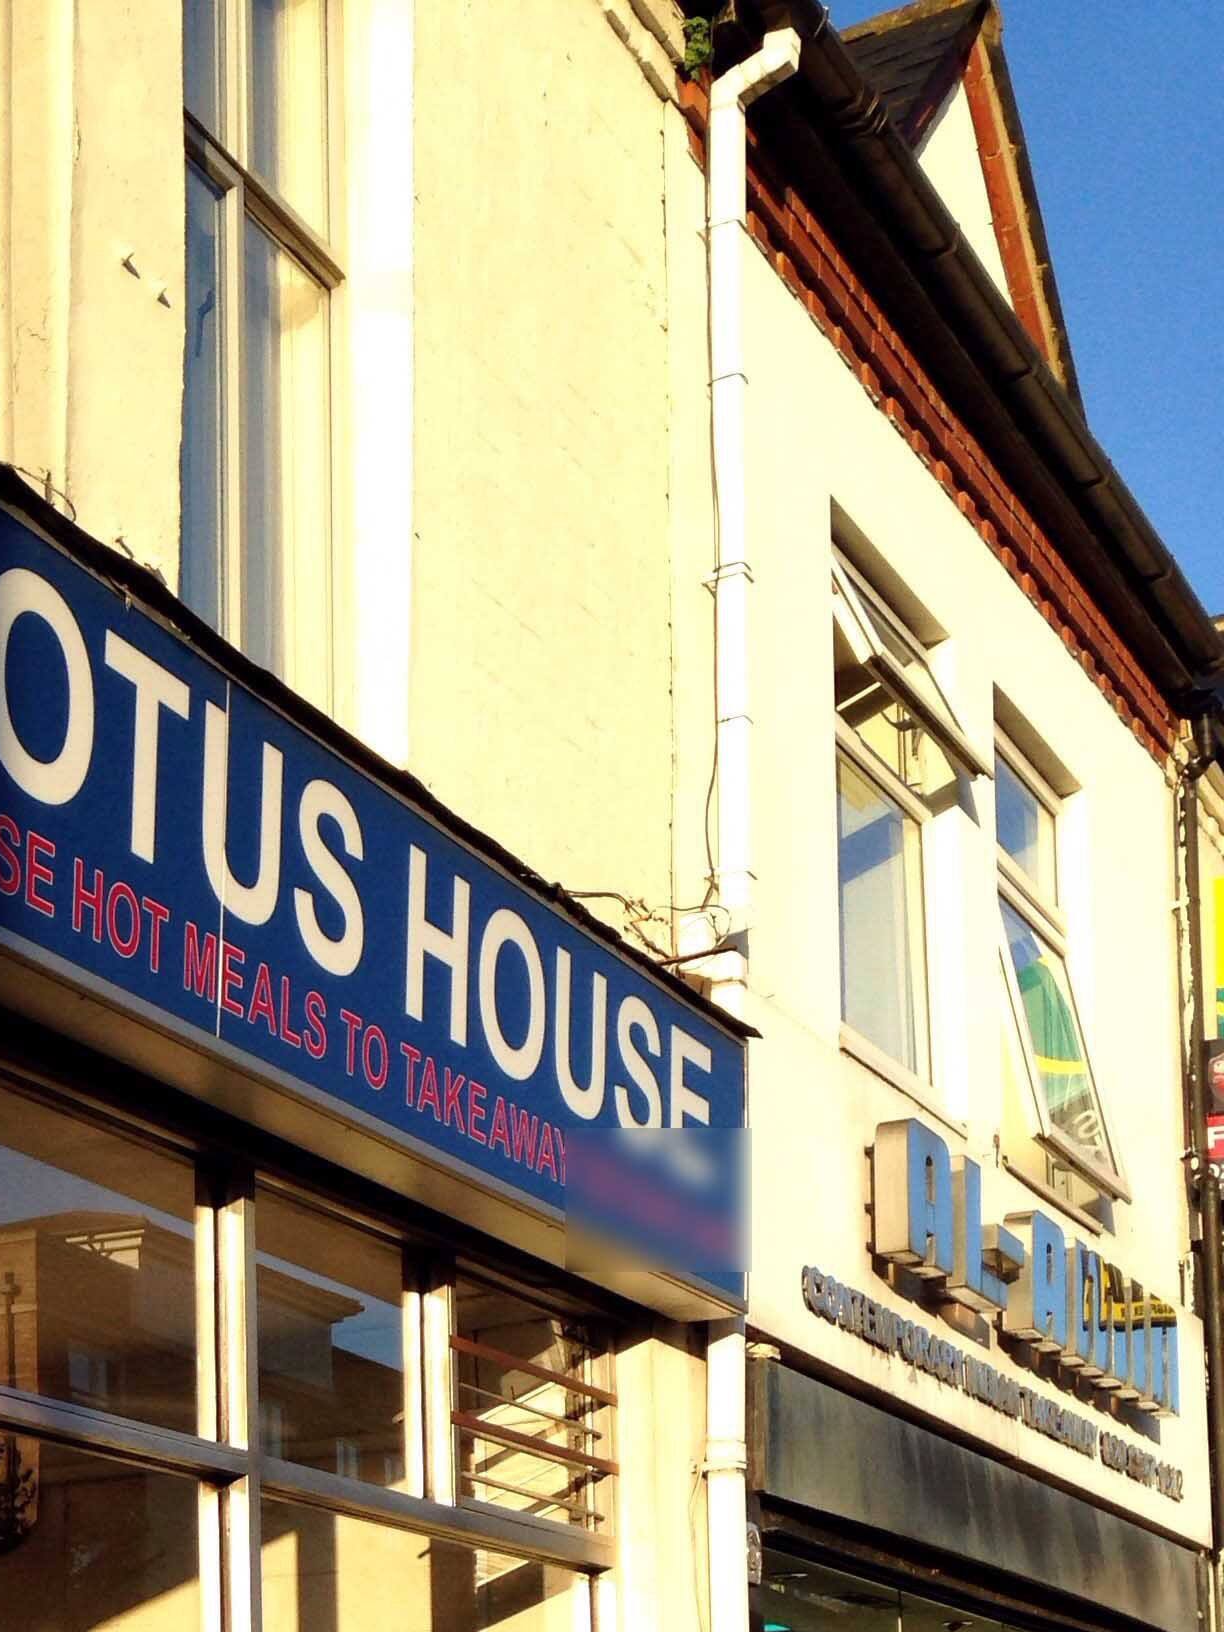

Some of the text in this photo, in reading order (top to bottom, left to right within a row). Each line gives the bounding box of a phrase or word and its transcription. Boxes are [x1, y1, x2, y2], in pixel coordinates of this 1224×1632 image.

[71, 857, 170, 974] HOT
[184, 921, 327, 1060] MEALS
[340, 1008, 389, 1091] TO
[405, 843, 713, 1187] HOUSE
